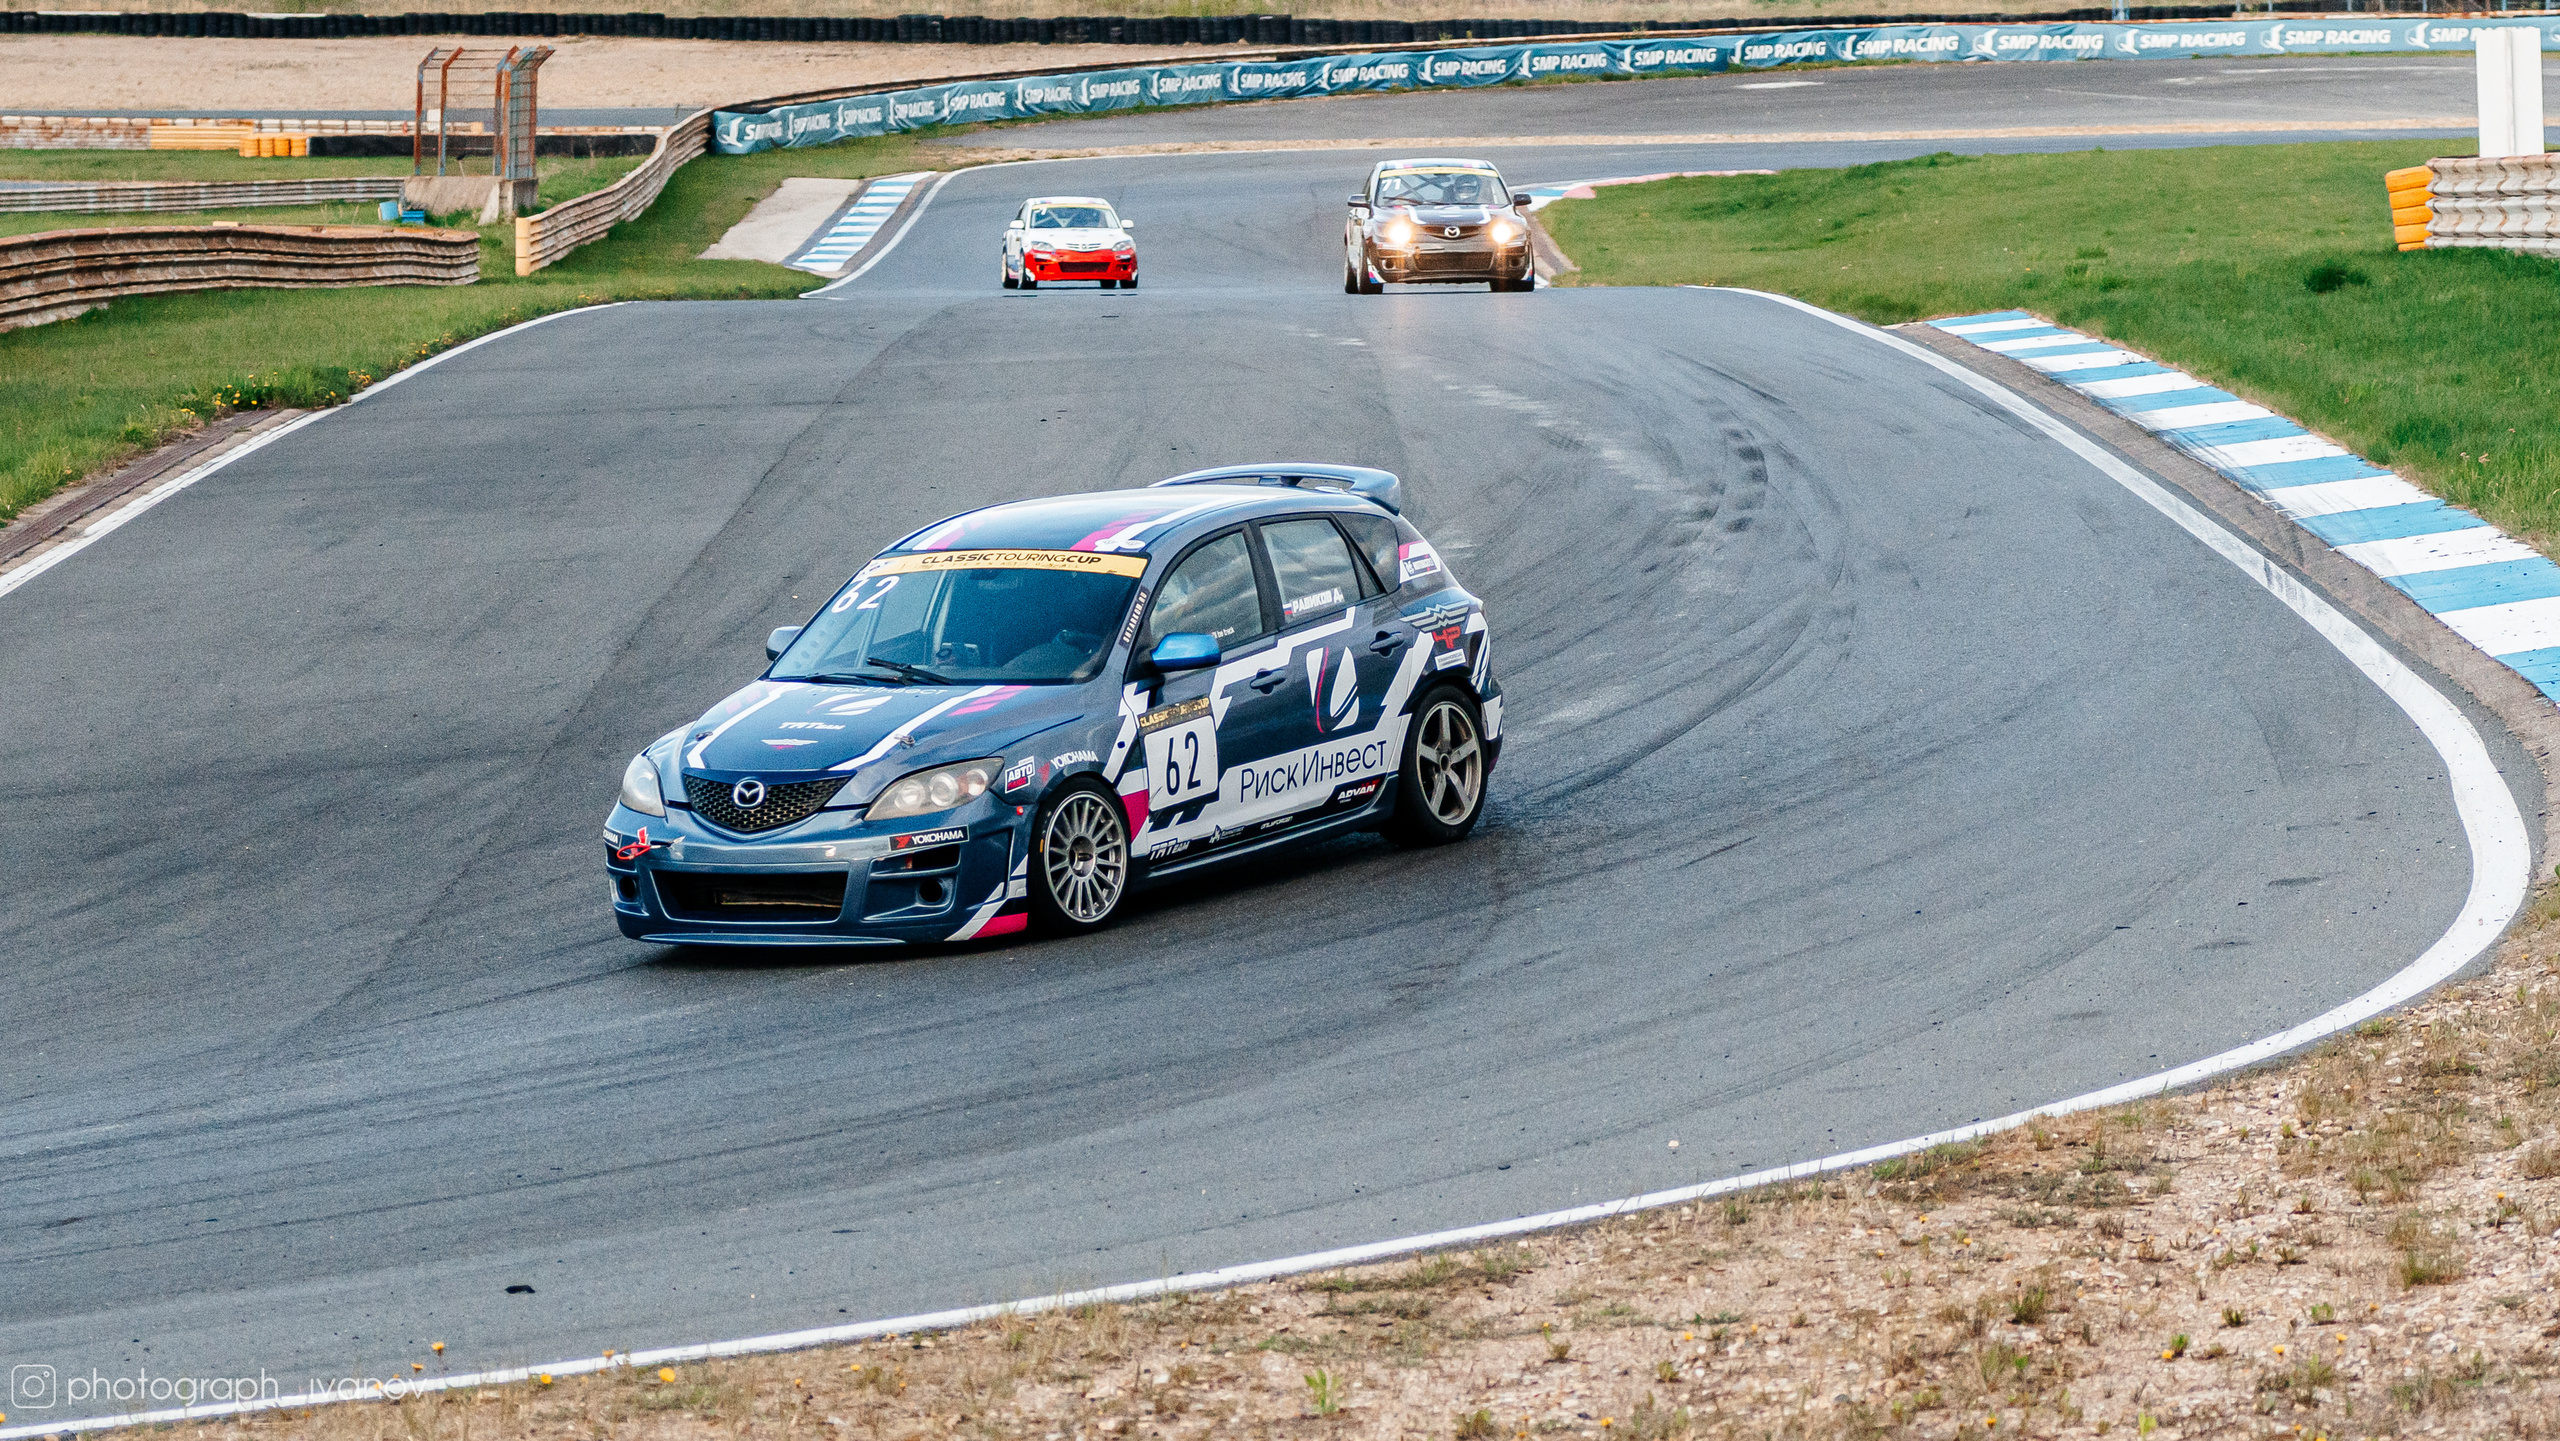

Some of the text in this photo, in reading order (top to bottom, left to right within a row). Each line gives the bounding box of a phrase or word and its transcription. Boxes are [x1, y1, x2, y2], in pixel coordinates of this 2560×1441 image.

[1998, 34, 2104, 50] SMP RACING
[2140, 32, 2247, 49] SMP RACING
[2284, 29, 2392, 45] SMP RACING
[2430, 27, 2469, 43] SMP
[1744, 41, 1827, 61] SMP RACING
[1855, 36, 1959, 55] SMP RACING
[1532, 53, 1607, 71] SMP RACING
[1634, 48, 1717, 66] SMP RACING
[1331, 63, 1409, 83] SMP RACING
[1434, 59, 1506, 76] SMP RACING
[1159, 73, 1221, 93] SMP RACING
[1241, 71, 1306, 88] SMP RACING
[1090, 79, 1140, 99] SMP RACING
[1381, 178, 1401, 192] 71
[831, 576, 900, 613] 62
[1050, 750, 1099, 769] YOKOHAMA
[1166, 731, 1201, 796] 62
[1007, 763, 1033, 783] АВТО
[1337, 784, 1376, 800] ADVAN
[911, 830, 964, 845] YOKOHAMA
